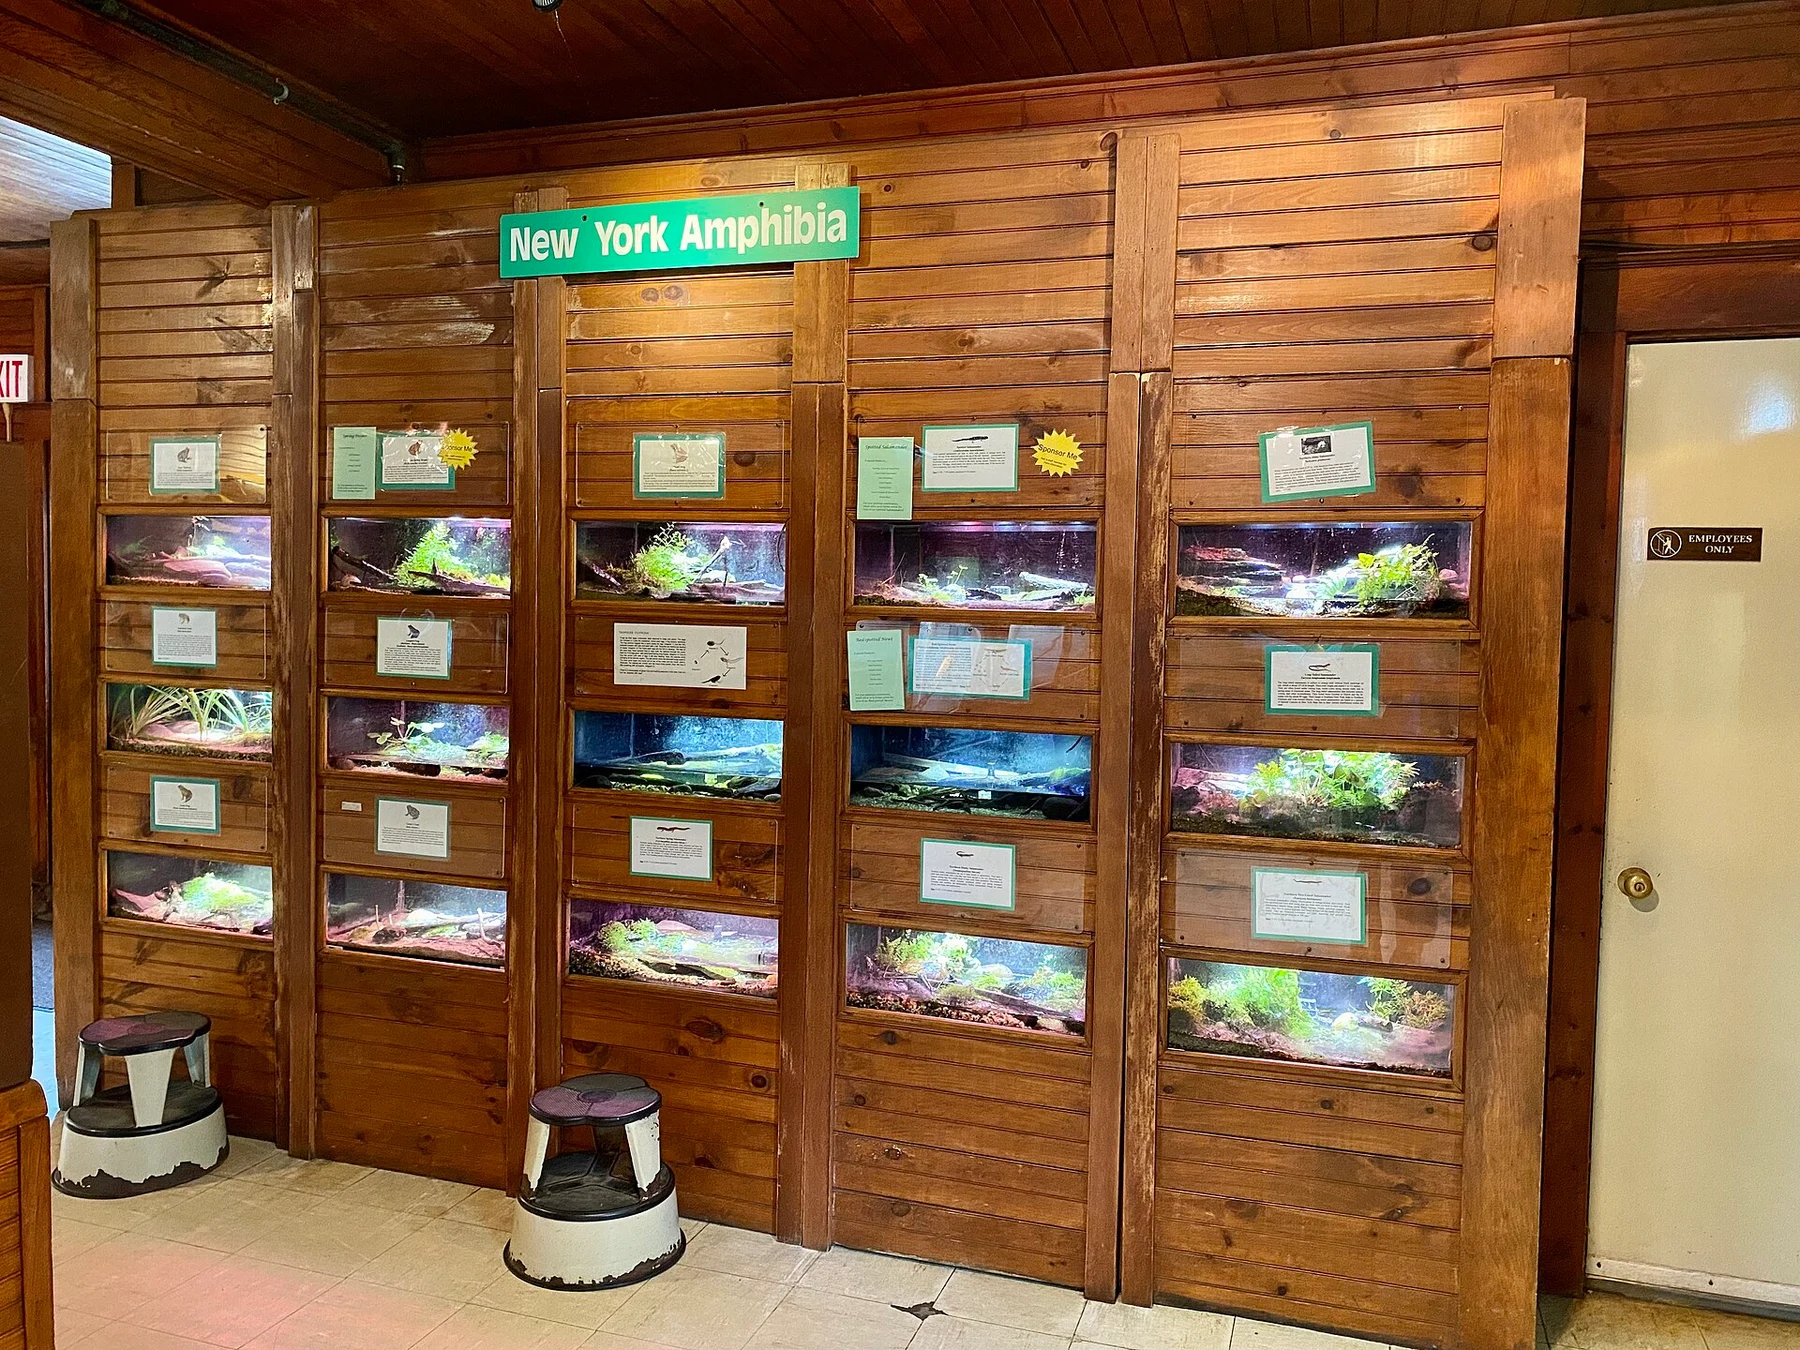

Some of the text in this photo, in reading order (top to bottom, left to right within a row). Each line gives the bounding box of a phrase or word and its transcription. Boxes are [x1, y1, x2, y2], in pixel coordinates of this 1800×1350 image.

[510, 201, 847, 262] New York Amphibia
[1038, 444, 1078, 460] Sponsor Me
[1688, 534, 1753, 543] EMPLOYEES
[1704, 545, 1734, 554] ONLY
